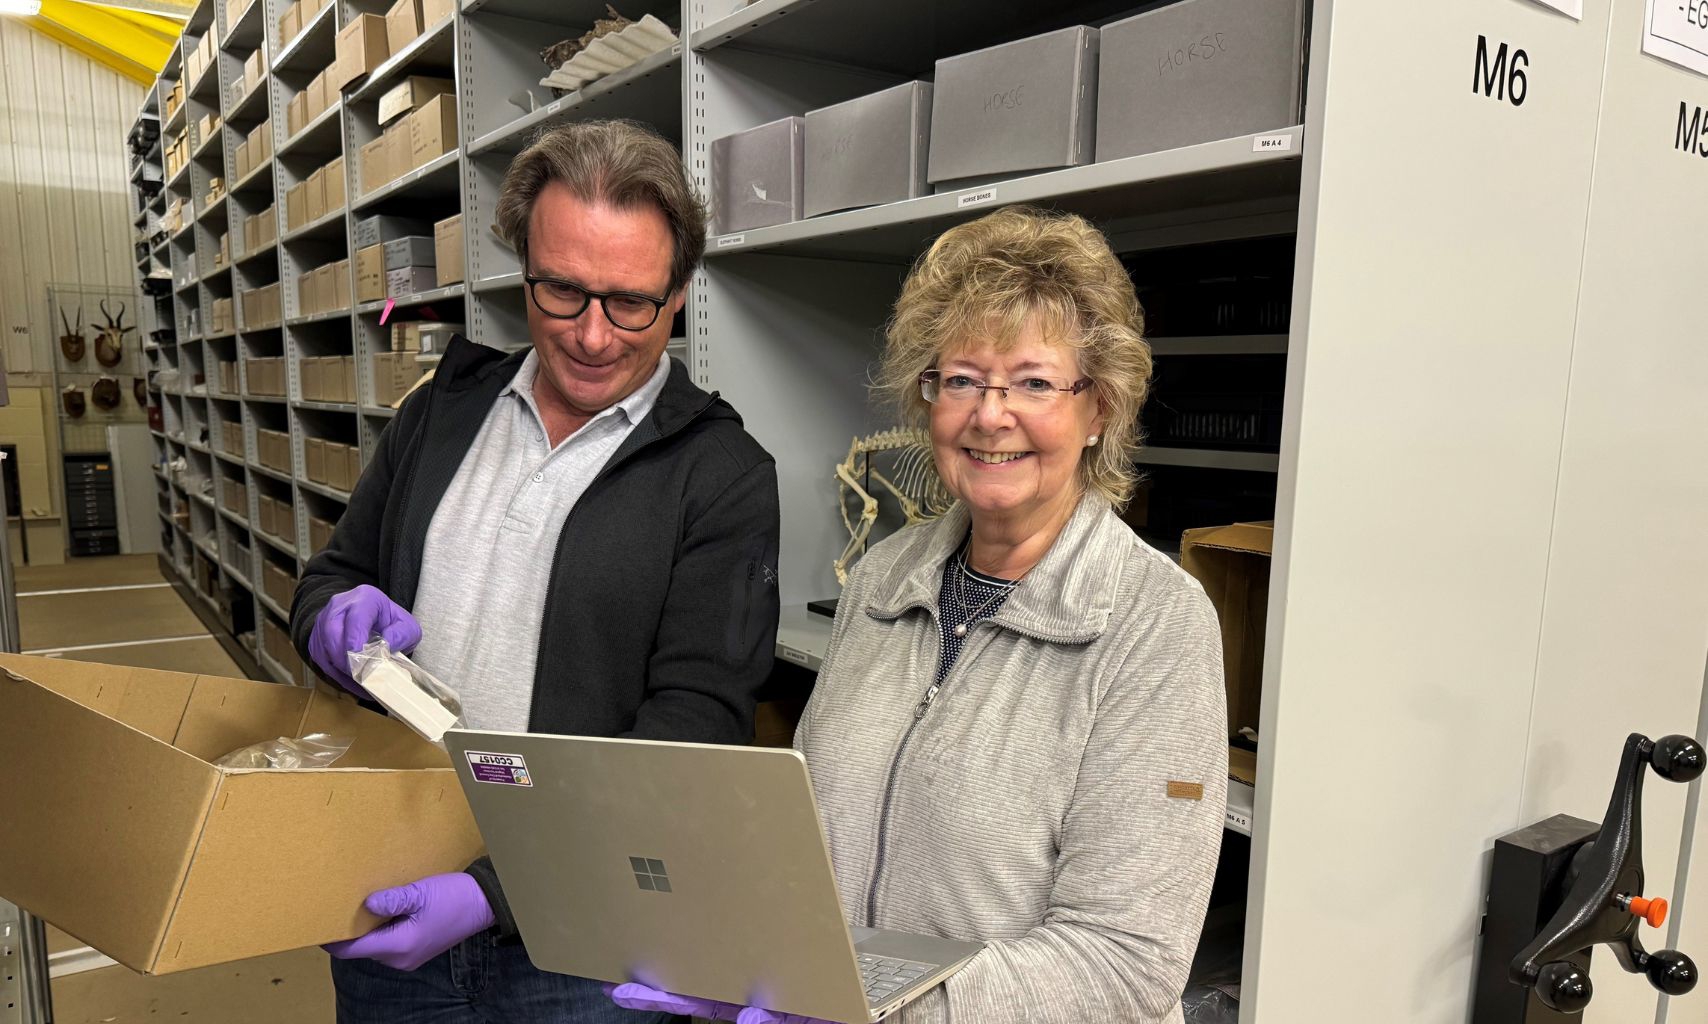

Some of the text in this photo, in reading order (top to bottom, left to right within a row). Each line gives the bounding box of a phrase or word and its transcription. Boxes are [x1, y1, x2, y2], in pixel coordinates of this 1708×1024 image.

[1158, 32, 1226, 77] HORSE
[1472, 34, 1529, 106] M6
[983, 85, 1025, 112] HORSE
[480, 755, 513, 765] CC0157
